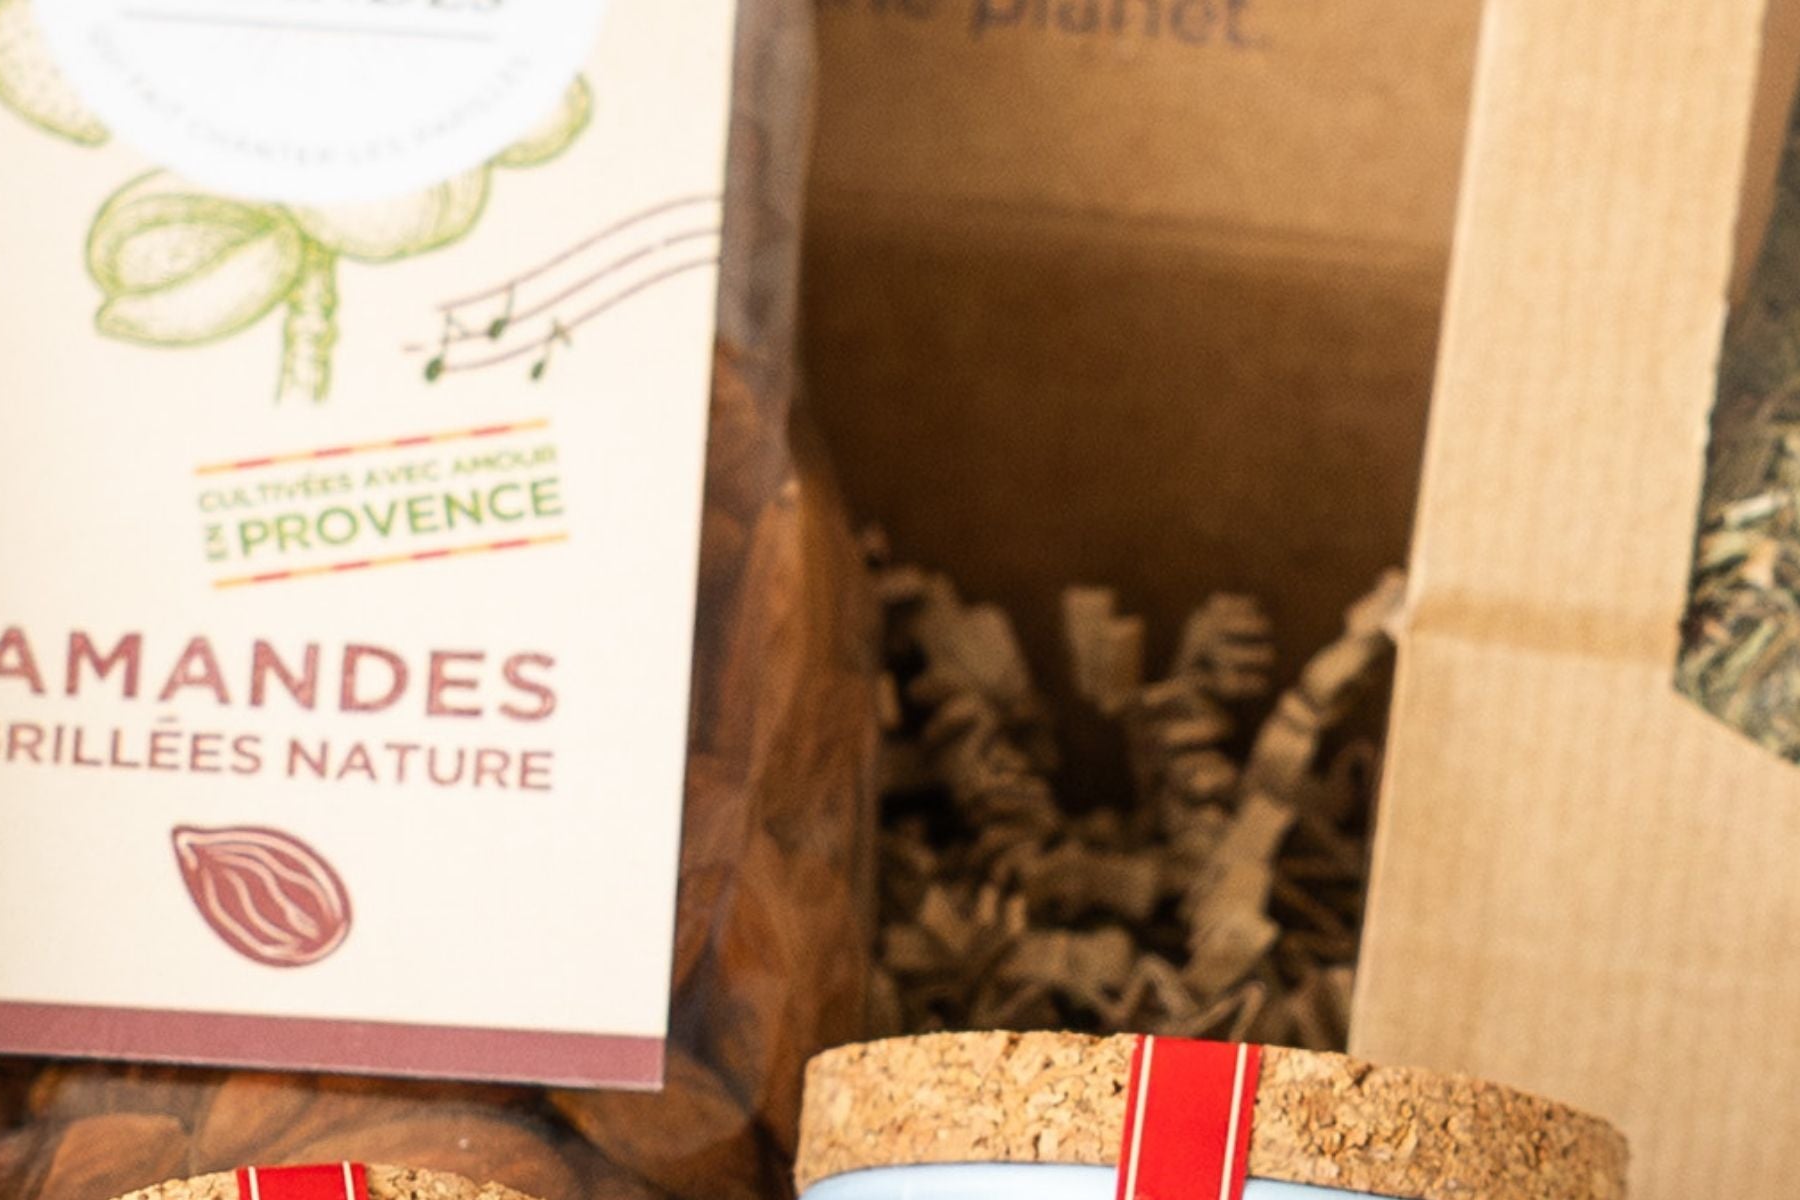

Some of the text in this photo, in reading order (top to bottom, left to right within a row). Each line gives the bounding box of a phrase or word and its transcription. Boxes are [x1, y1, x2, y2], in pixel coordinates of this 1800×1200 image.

[199, 445, 558, 513] CULTIVÉES AVEC AMOUR
[203, 476, 566, 563] EN PROVENCE
[284, 739, 557, 794] NATURE
